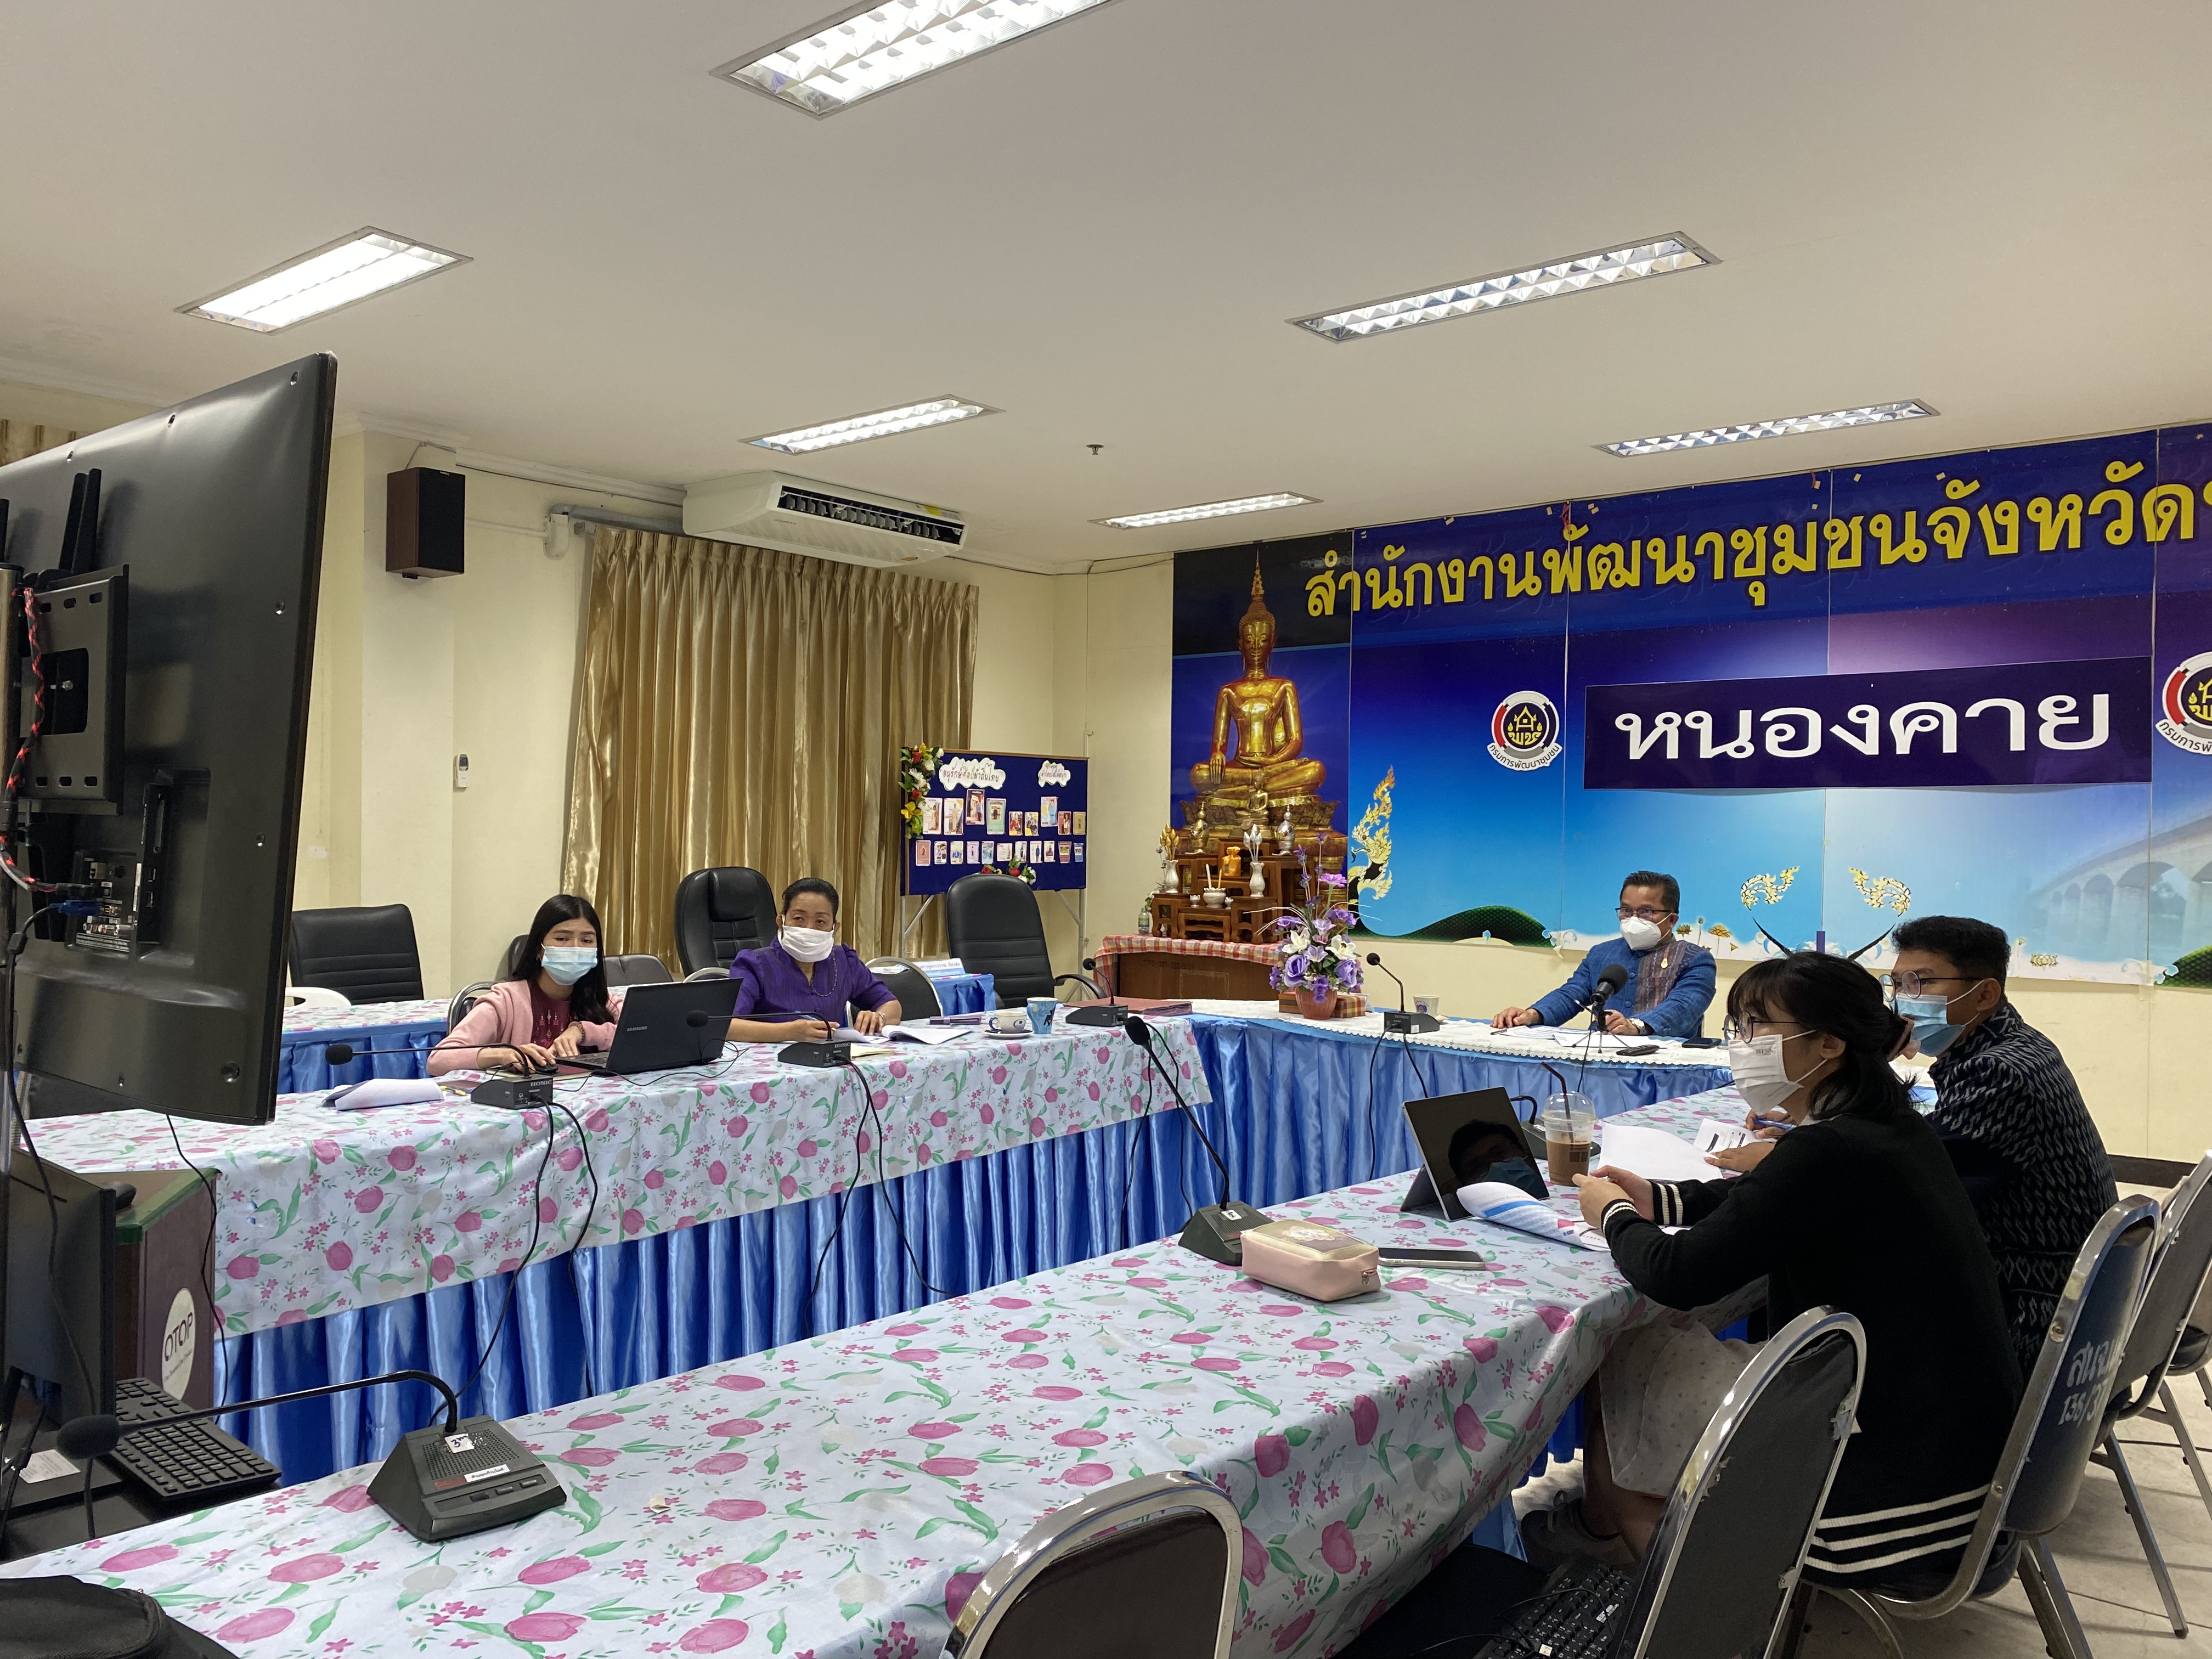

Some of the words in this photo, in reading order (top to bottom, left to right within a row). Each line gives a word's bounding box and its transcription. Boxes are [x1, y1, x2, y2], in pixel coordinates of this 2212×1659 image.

[1305, 460, 2212, 617] สำนักงานพัฒนาชุมชนจังหวัด
[1488, 744, 1562, 769] กรมการพัฒนาชุมชน
[1615, 693, 2110, 761] หนองคาย
[164, 1311, 193, 1362] OTOP
